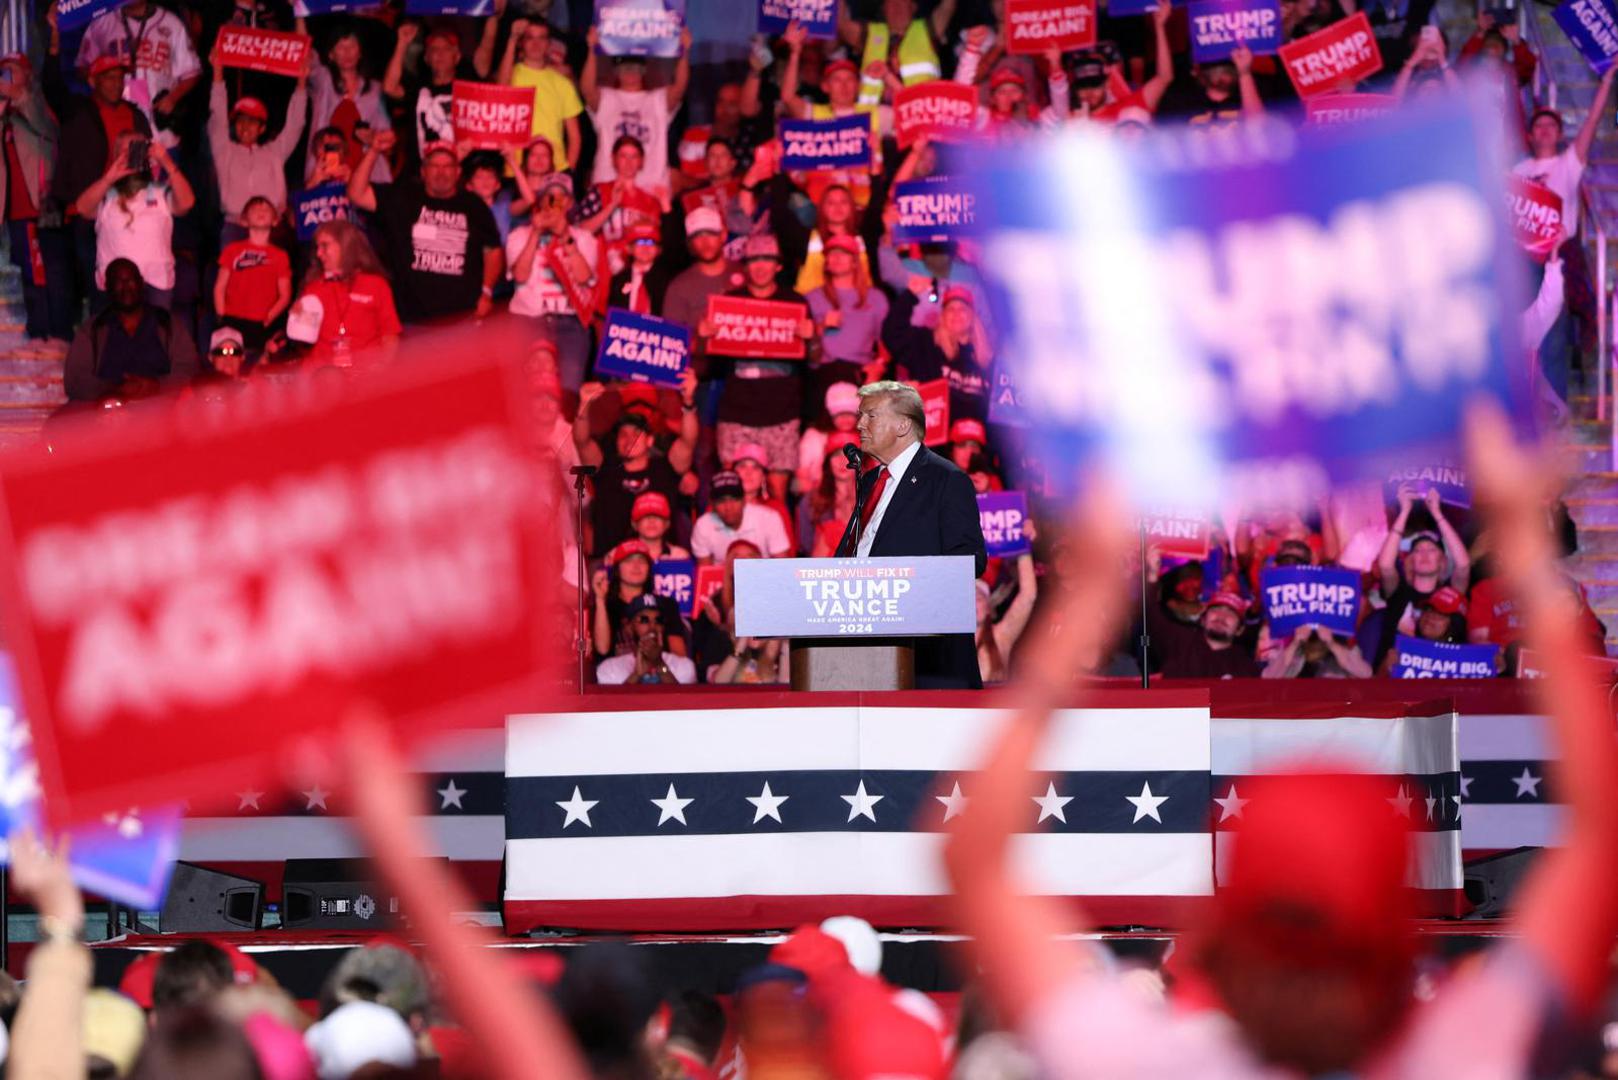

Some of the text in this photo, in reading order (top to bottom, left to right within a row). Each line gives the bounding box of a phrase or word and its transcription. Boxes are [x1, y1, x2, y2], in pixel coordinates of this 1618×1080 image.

[817, 10, 832, 23] IT
[1011, 9, 1062, 24] DREAM
[1193, 8, 1276, 34] TRUMP
[603, 20, 679, 39] AGAIN!
[1013, 16, 1086, 39] AGAIN!
[1196, 25, 1275, 46] WILL FIX IT
[222, 43, 301, 62] WILL FIX IT
[223, 32, 304, 55] TRUMP
[1290, 31, 1369, 75] TRUMP
[1298, 45, 1373, 87] WILL FIX IT
[455, 98, 531, 122] TRUMP
[898, 96, 973, 120] TRUMP
[488, 119, 513, 134] FIX
[514, 120, 529, 134] IT
[900, 112, 933, 131] WILL
[784, 129, 838, 143] DREAM
[786, 138, 863, 157] AGAIN!
[897, 193, 976, 215] TRUMP
[899, 210, 976, 227] WILL FIX IT
[1539, 225, 1557, 239] IT
[714, 312, 769, 329] DREAM
[608, 323, 662, 349] DREAM
[715, 326, 796, 344] AGAIN!
[605, 338, 682, 371] AGAIN!
[1006, 527, 1022, 541] IT
[800, 567, 911, 579] TRUMP WILL FIX IT
[799, 579, 911, 600] TRUMP
[1266, 582, 1355, 606] TRUMP
[813, 599, 899, 616] VANCE
[1269, 601, 1354, 618] WILL FIX IT
[839, 623, 873, 633] 2024
[1400, 652, 1458, 674] DREAM
[1460, 661, 1492, 676] BIG,
